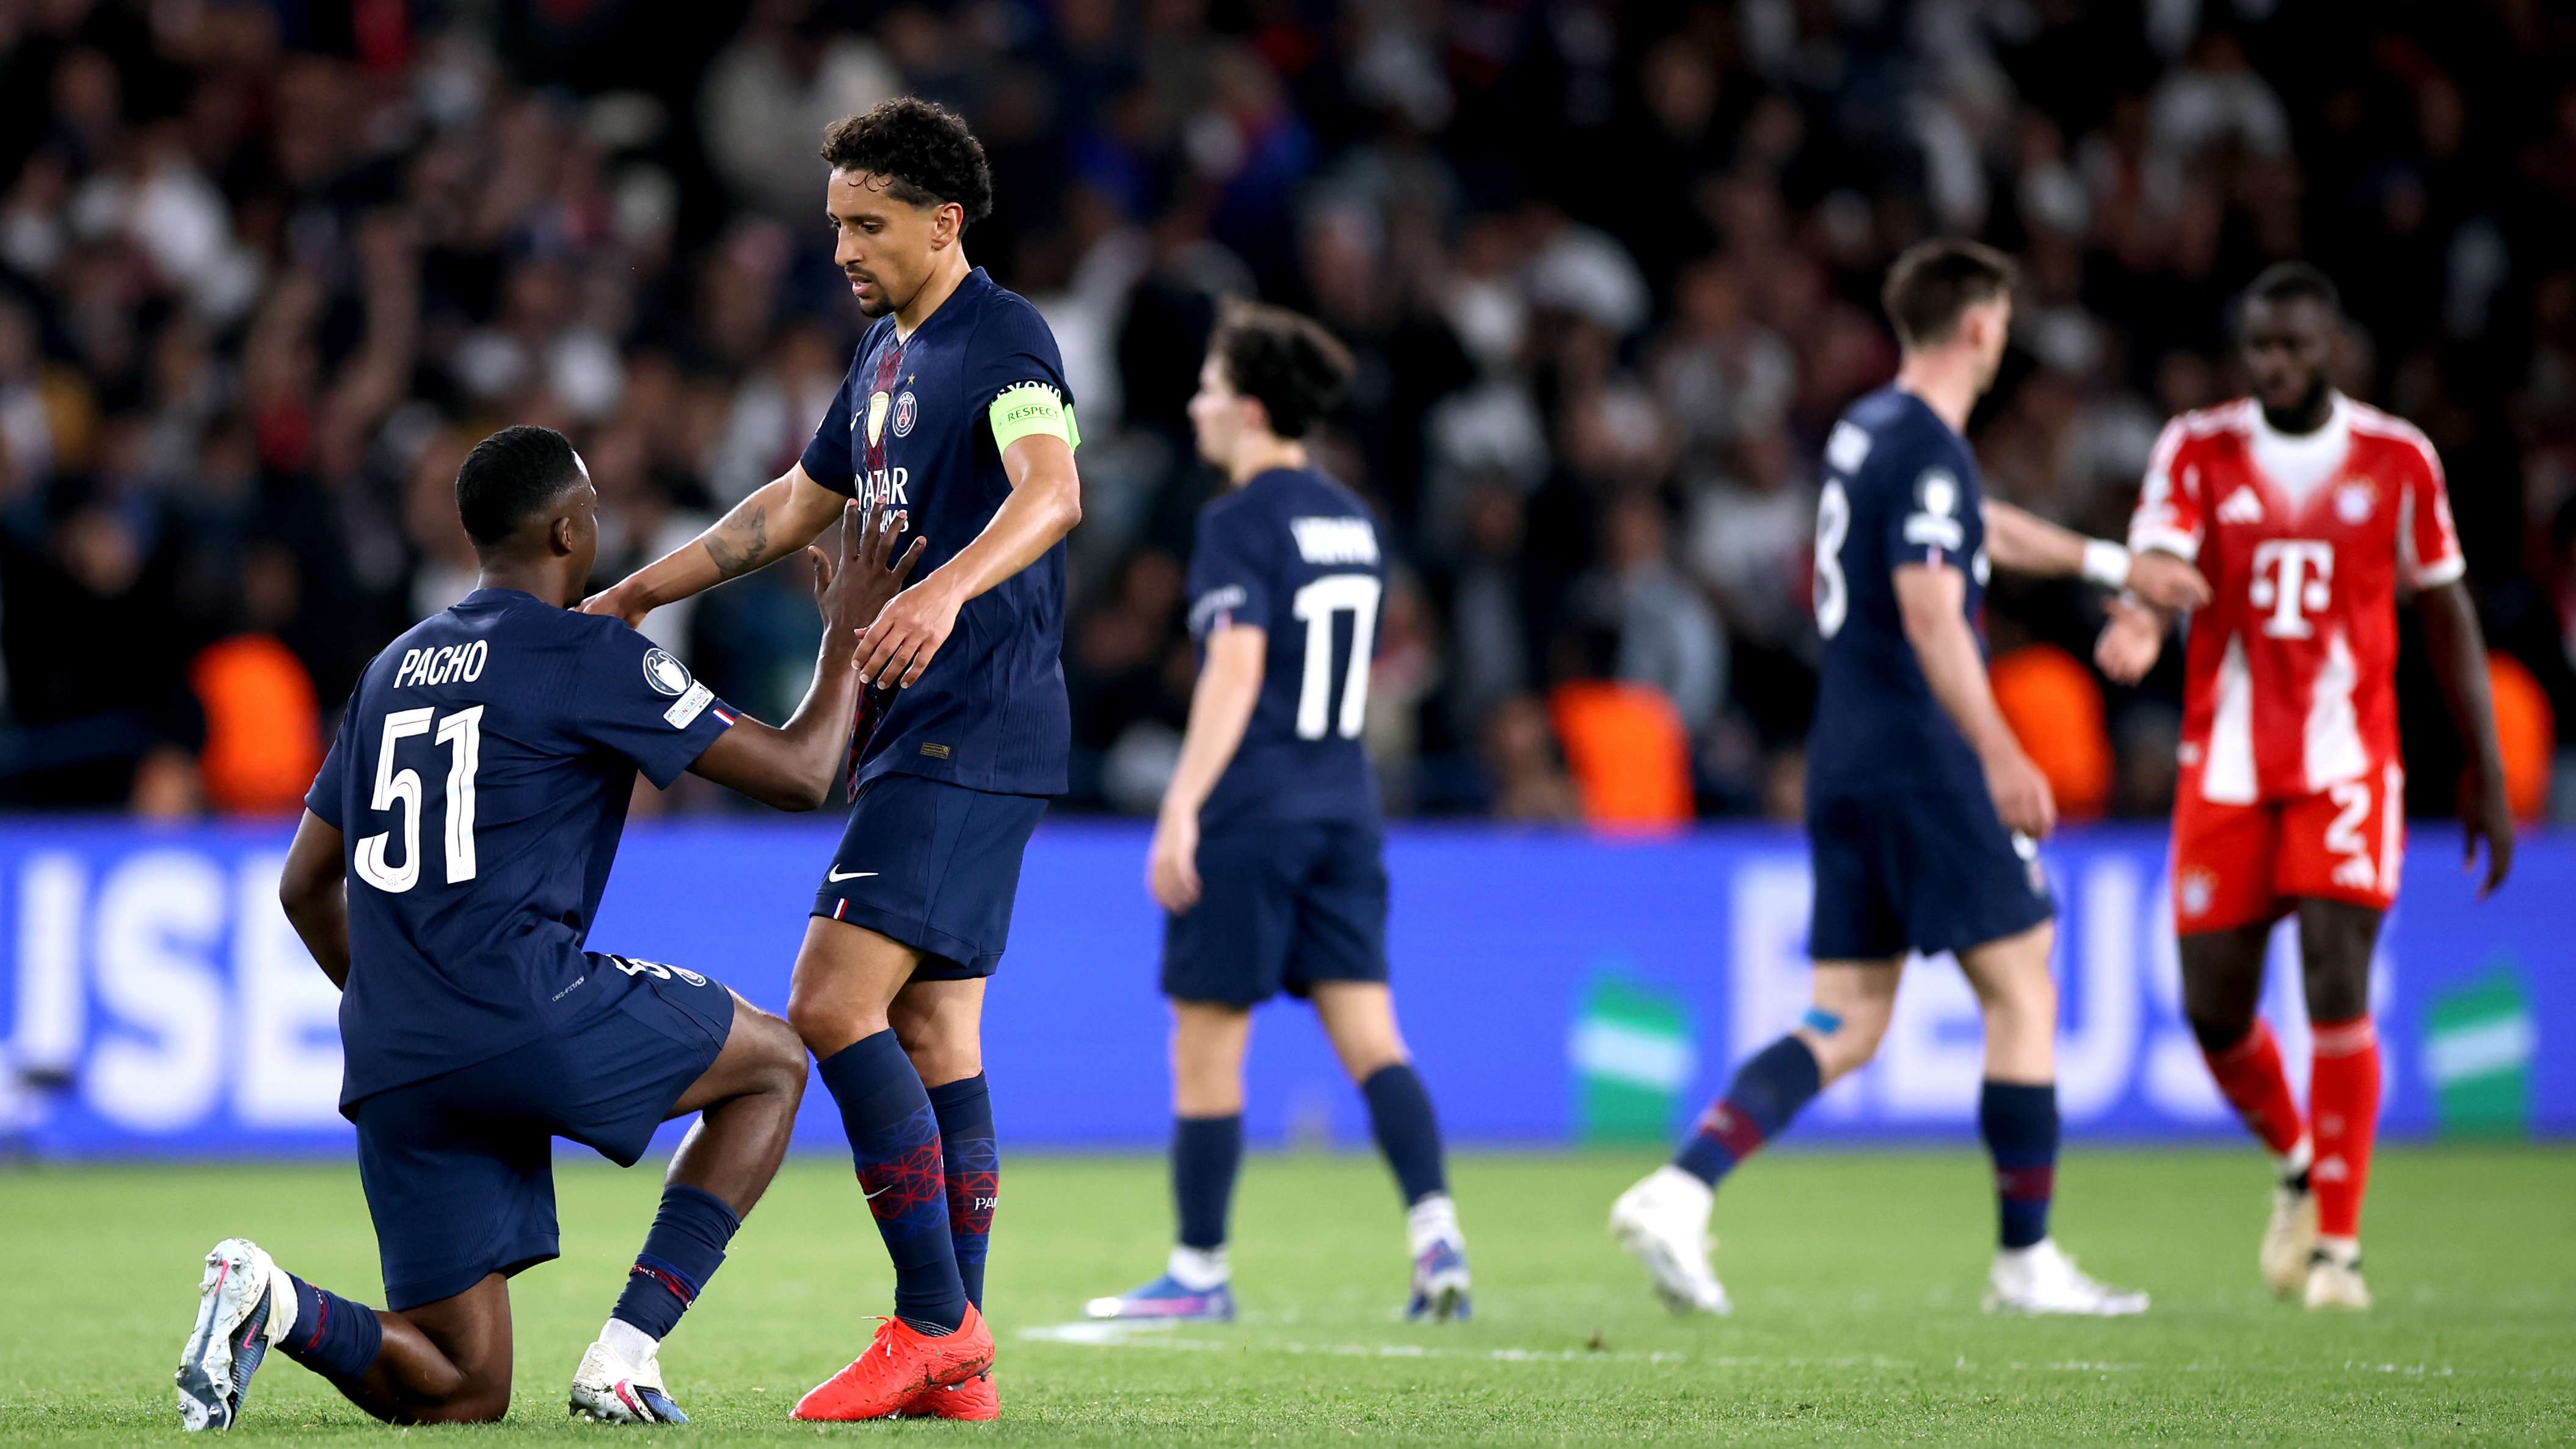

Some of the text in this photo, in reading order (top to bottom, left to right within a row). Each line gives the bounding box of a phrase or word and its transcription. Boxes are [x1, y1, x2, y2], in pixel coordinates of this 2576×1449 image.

[899, 394, 914, 405] PARIS
[1008, 407, 1058, 422] RESPECT
[854, 467, 908, 511] QATAR
[2249, 539, 2335, 639] T
[393, 639, 488, 688] PACHO
[1291, 573, 1382, 740] 17
[354, 705, 484, 893] 51
[2324, 780, 2372, 853] 2
